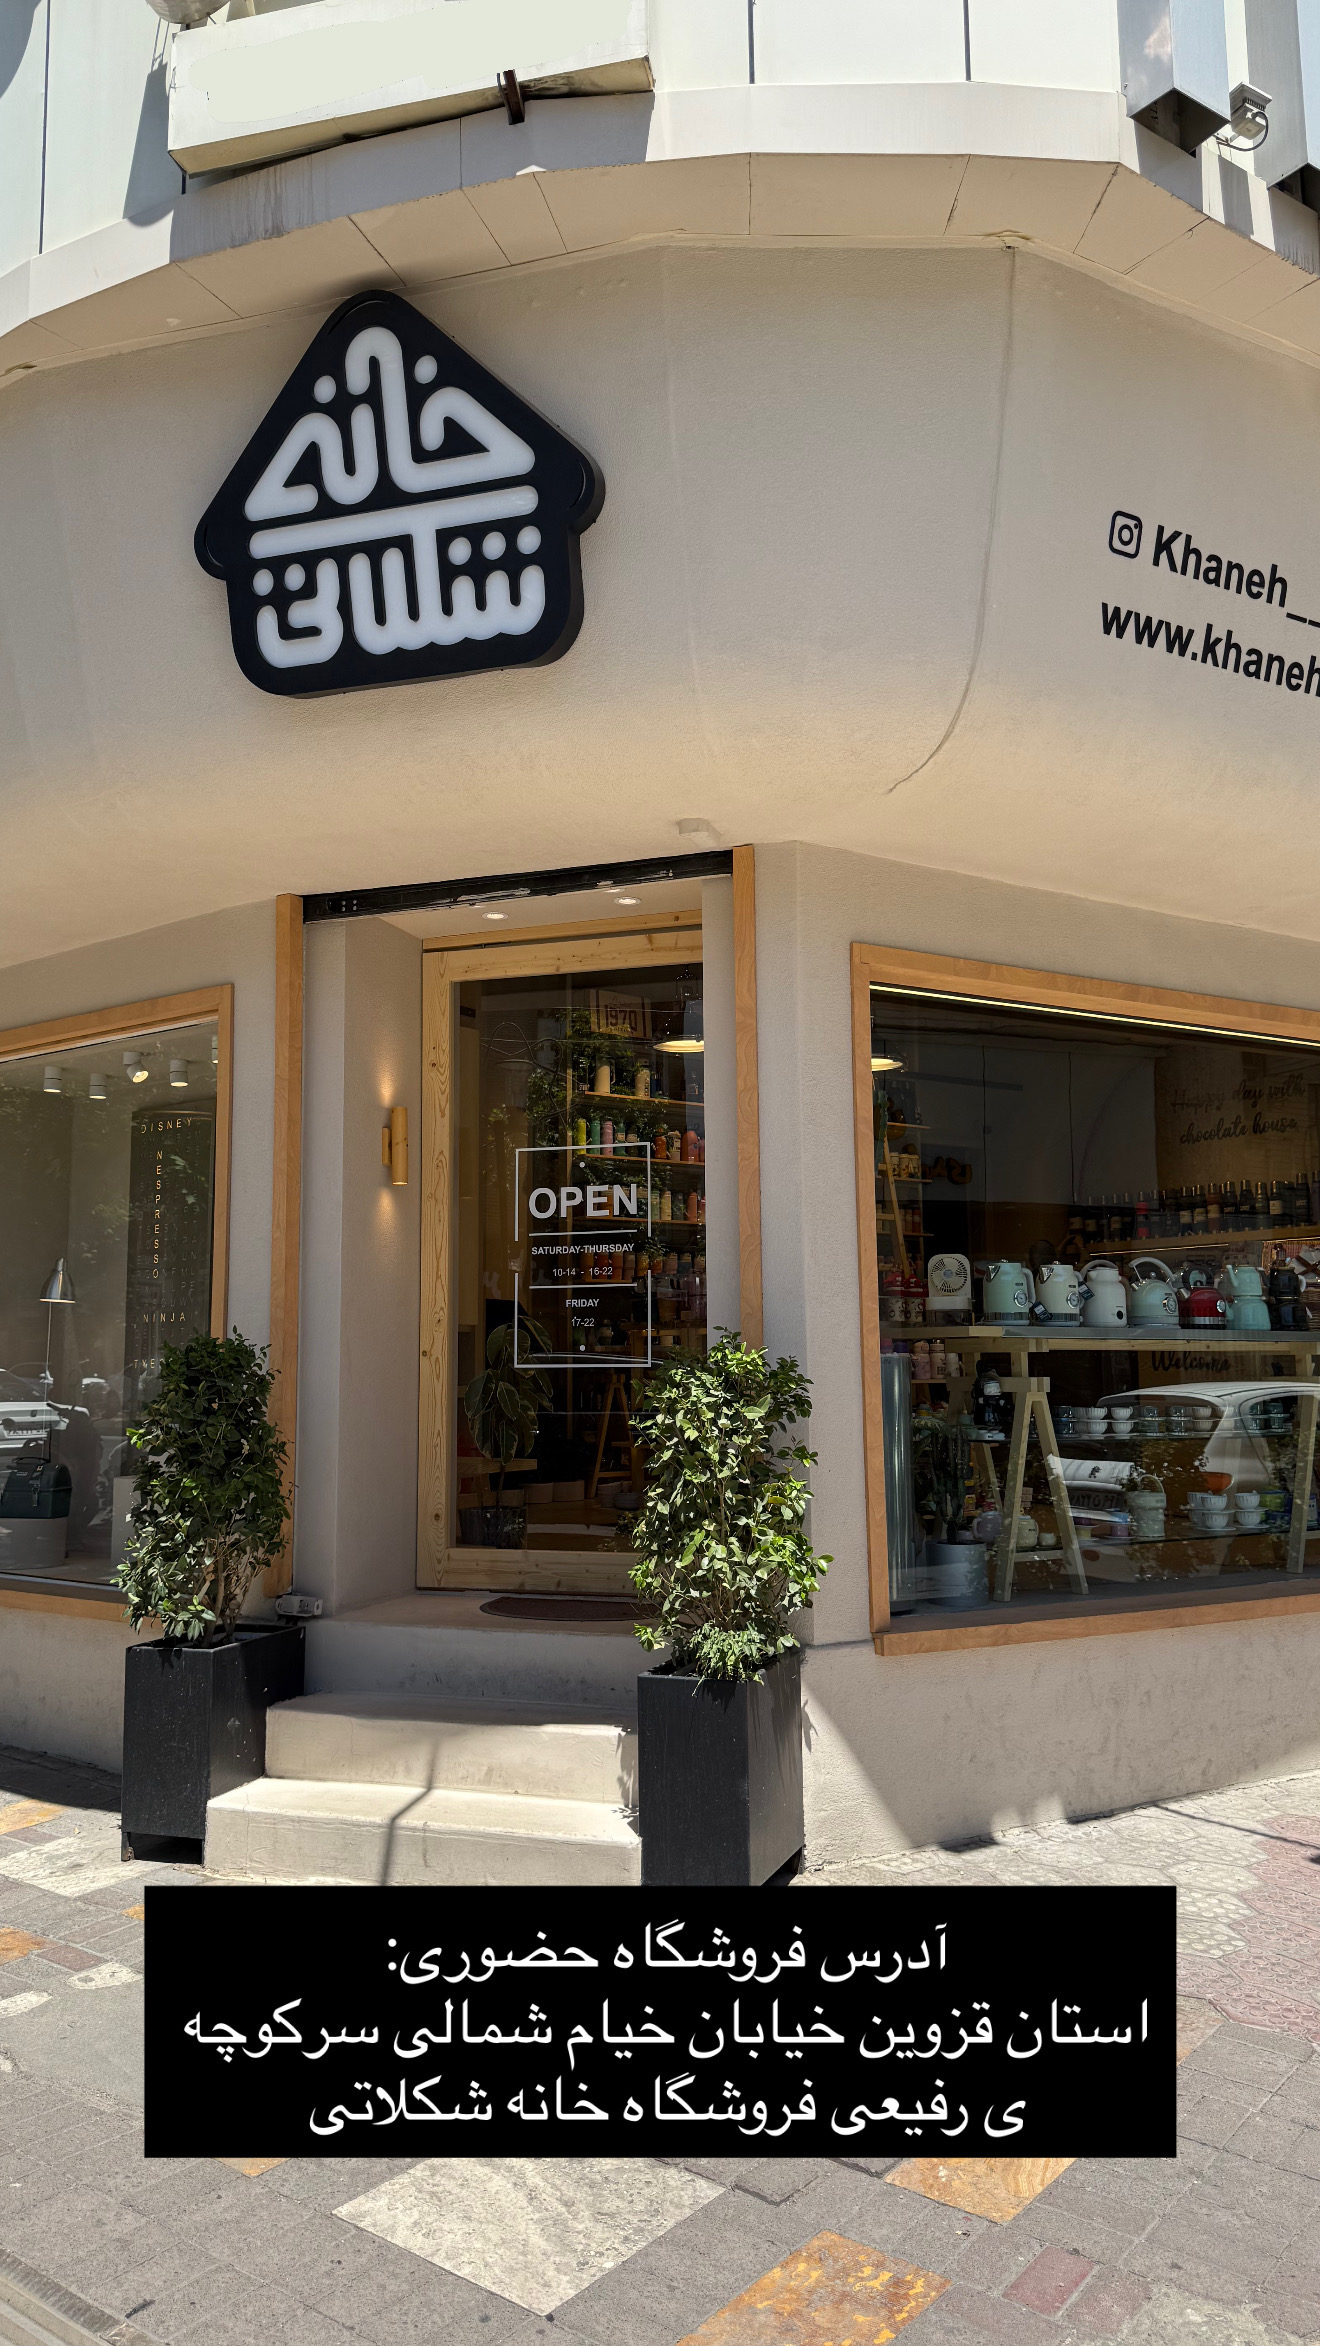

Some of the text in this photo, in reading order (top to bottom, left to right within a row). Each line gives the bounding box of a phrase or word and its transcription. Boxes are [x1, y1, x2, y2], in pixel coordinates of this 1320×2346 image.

[243, 326, 536, 522] خانه
[248, 485, 547, 669] شکلاتی
[1101, 602, 1320, 698] www.khaneh
[604, 1004, 638, 1032] 1970
[1232, 1078, 1264, 1109] day
[1268, 1072, 1307, 1098] with
[140, 1116, 193, 1134] DISNEY
[1180, 1111, 1297, 1144] chocolate house
[151, 1149, 163, 1279] NESPRESSO
[528, 1183, 638, 1219] OPEN
[531, 1243, 635, 1256] SATURDAY-THURSDAY
[552, 1267, 577, 1277] 10-14
[588, 1266, 613, 1276] 16-22
[565, 1298, 600, 1308] FRIDAY
[143, 1311, 186, 1324] NINJA
[571, 1316, 595, 1327] 17-22
[1151, 1350, 1232, 1373] Welcome
